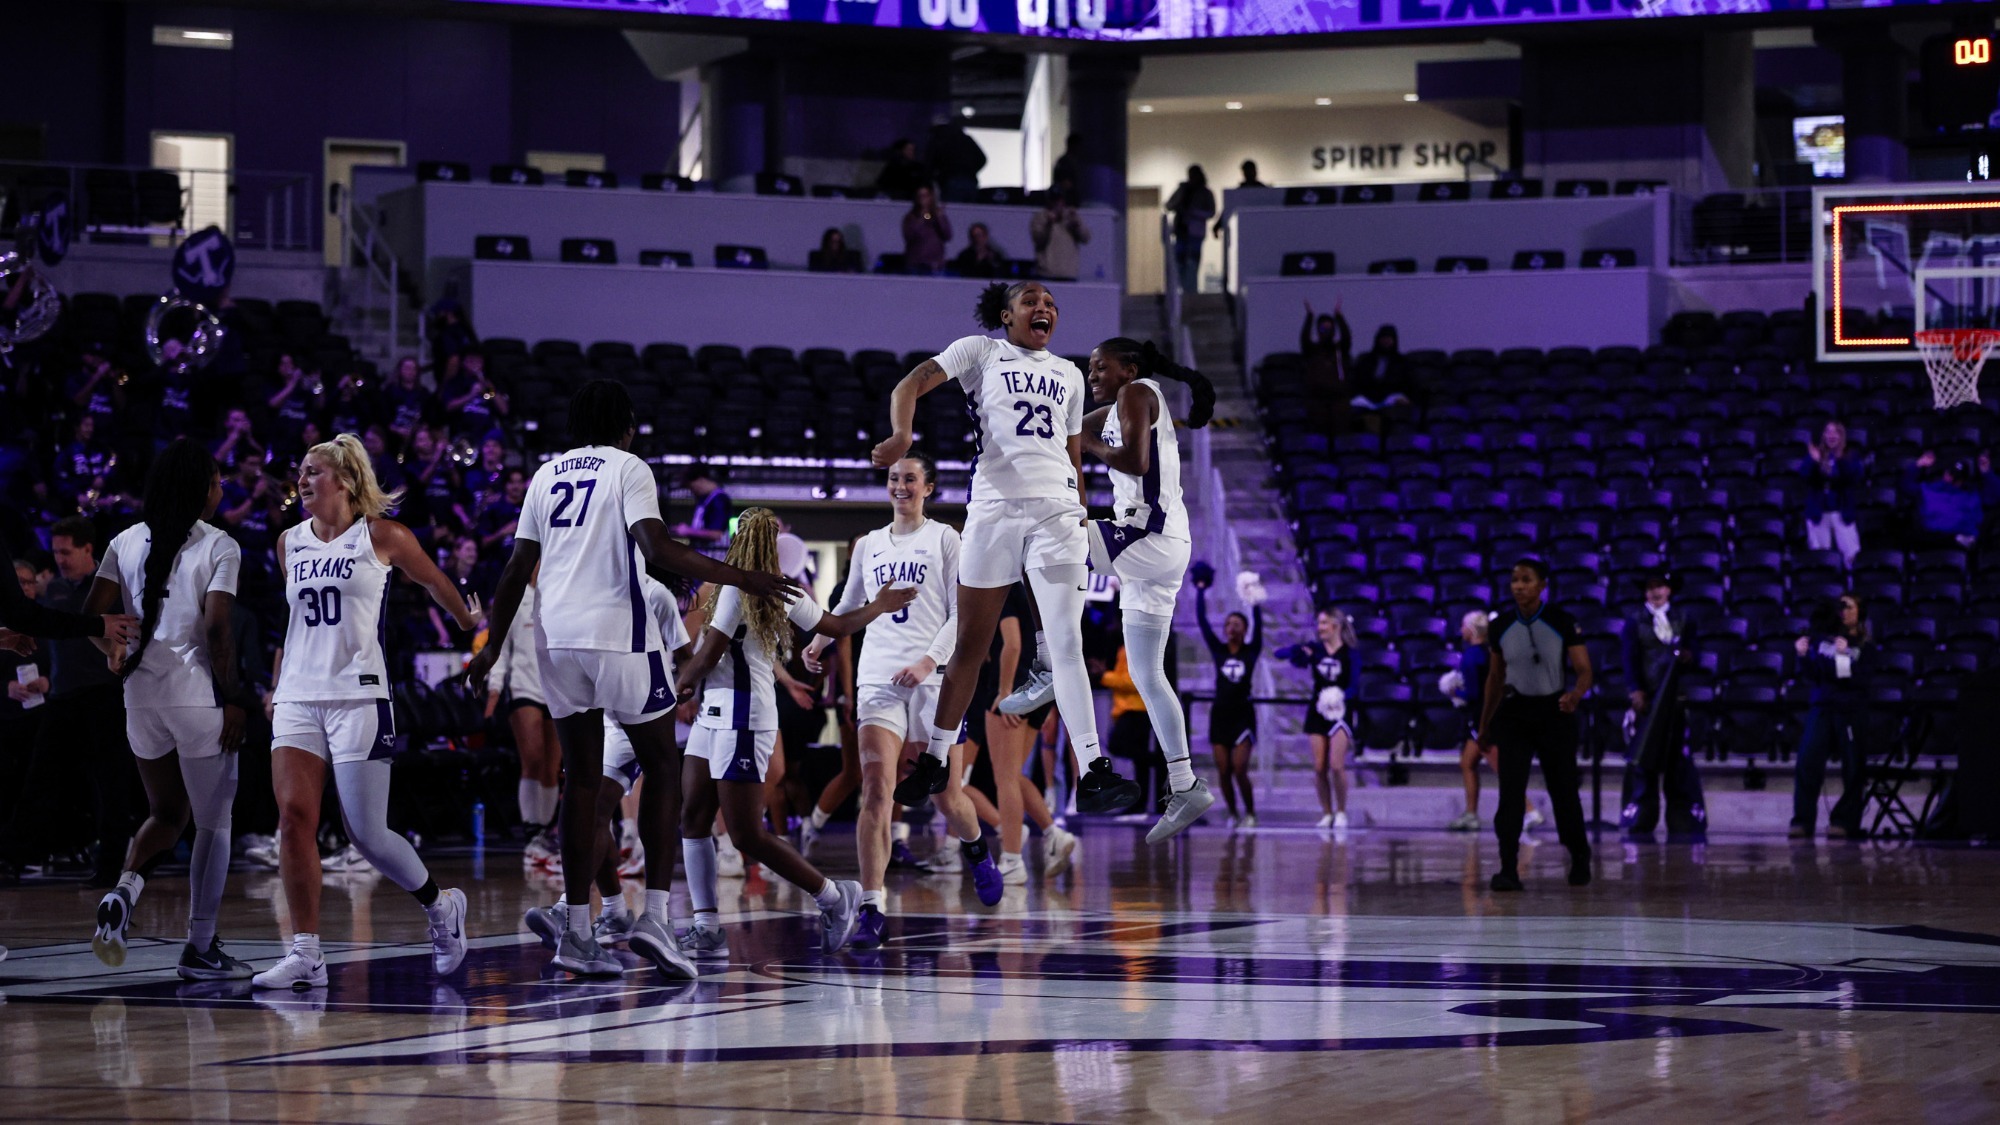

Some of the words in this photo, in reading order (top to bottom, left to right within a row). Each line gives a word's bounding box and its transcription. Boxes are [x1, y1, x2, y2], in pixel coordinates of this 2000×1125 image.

[1313, 145, 1403, 170] SPIRIT
[1415, 141, 1497, 167] SHOP
[1000, 371, 1067, 405] TEXANS
[1013, 400, 1055, 439] 23
[554, 456, 606, 476] LUTBERT
[549, 479, 598, 528] 27
[293, 557, 356, 584] TEXANS
[873, 561, 928, 587] TEXANS
[298, 585, 342, 628] 30
